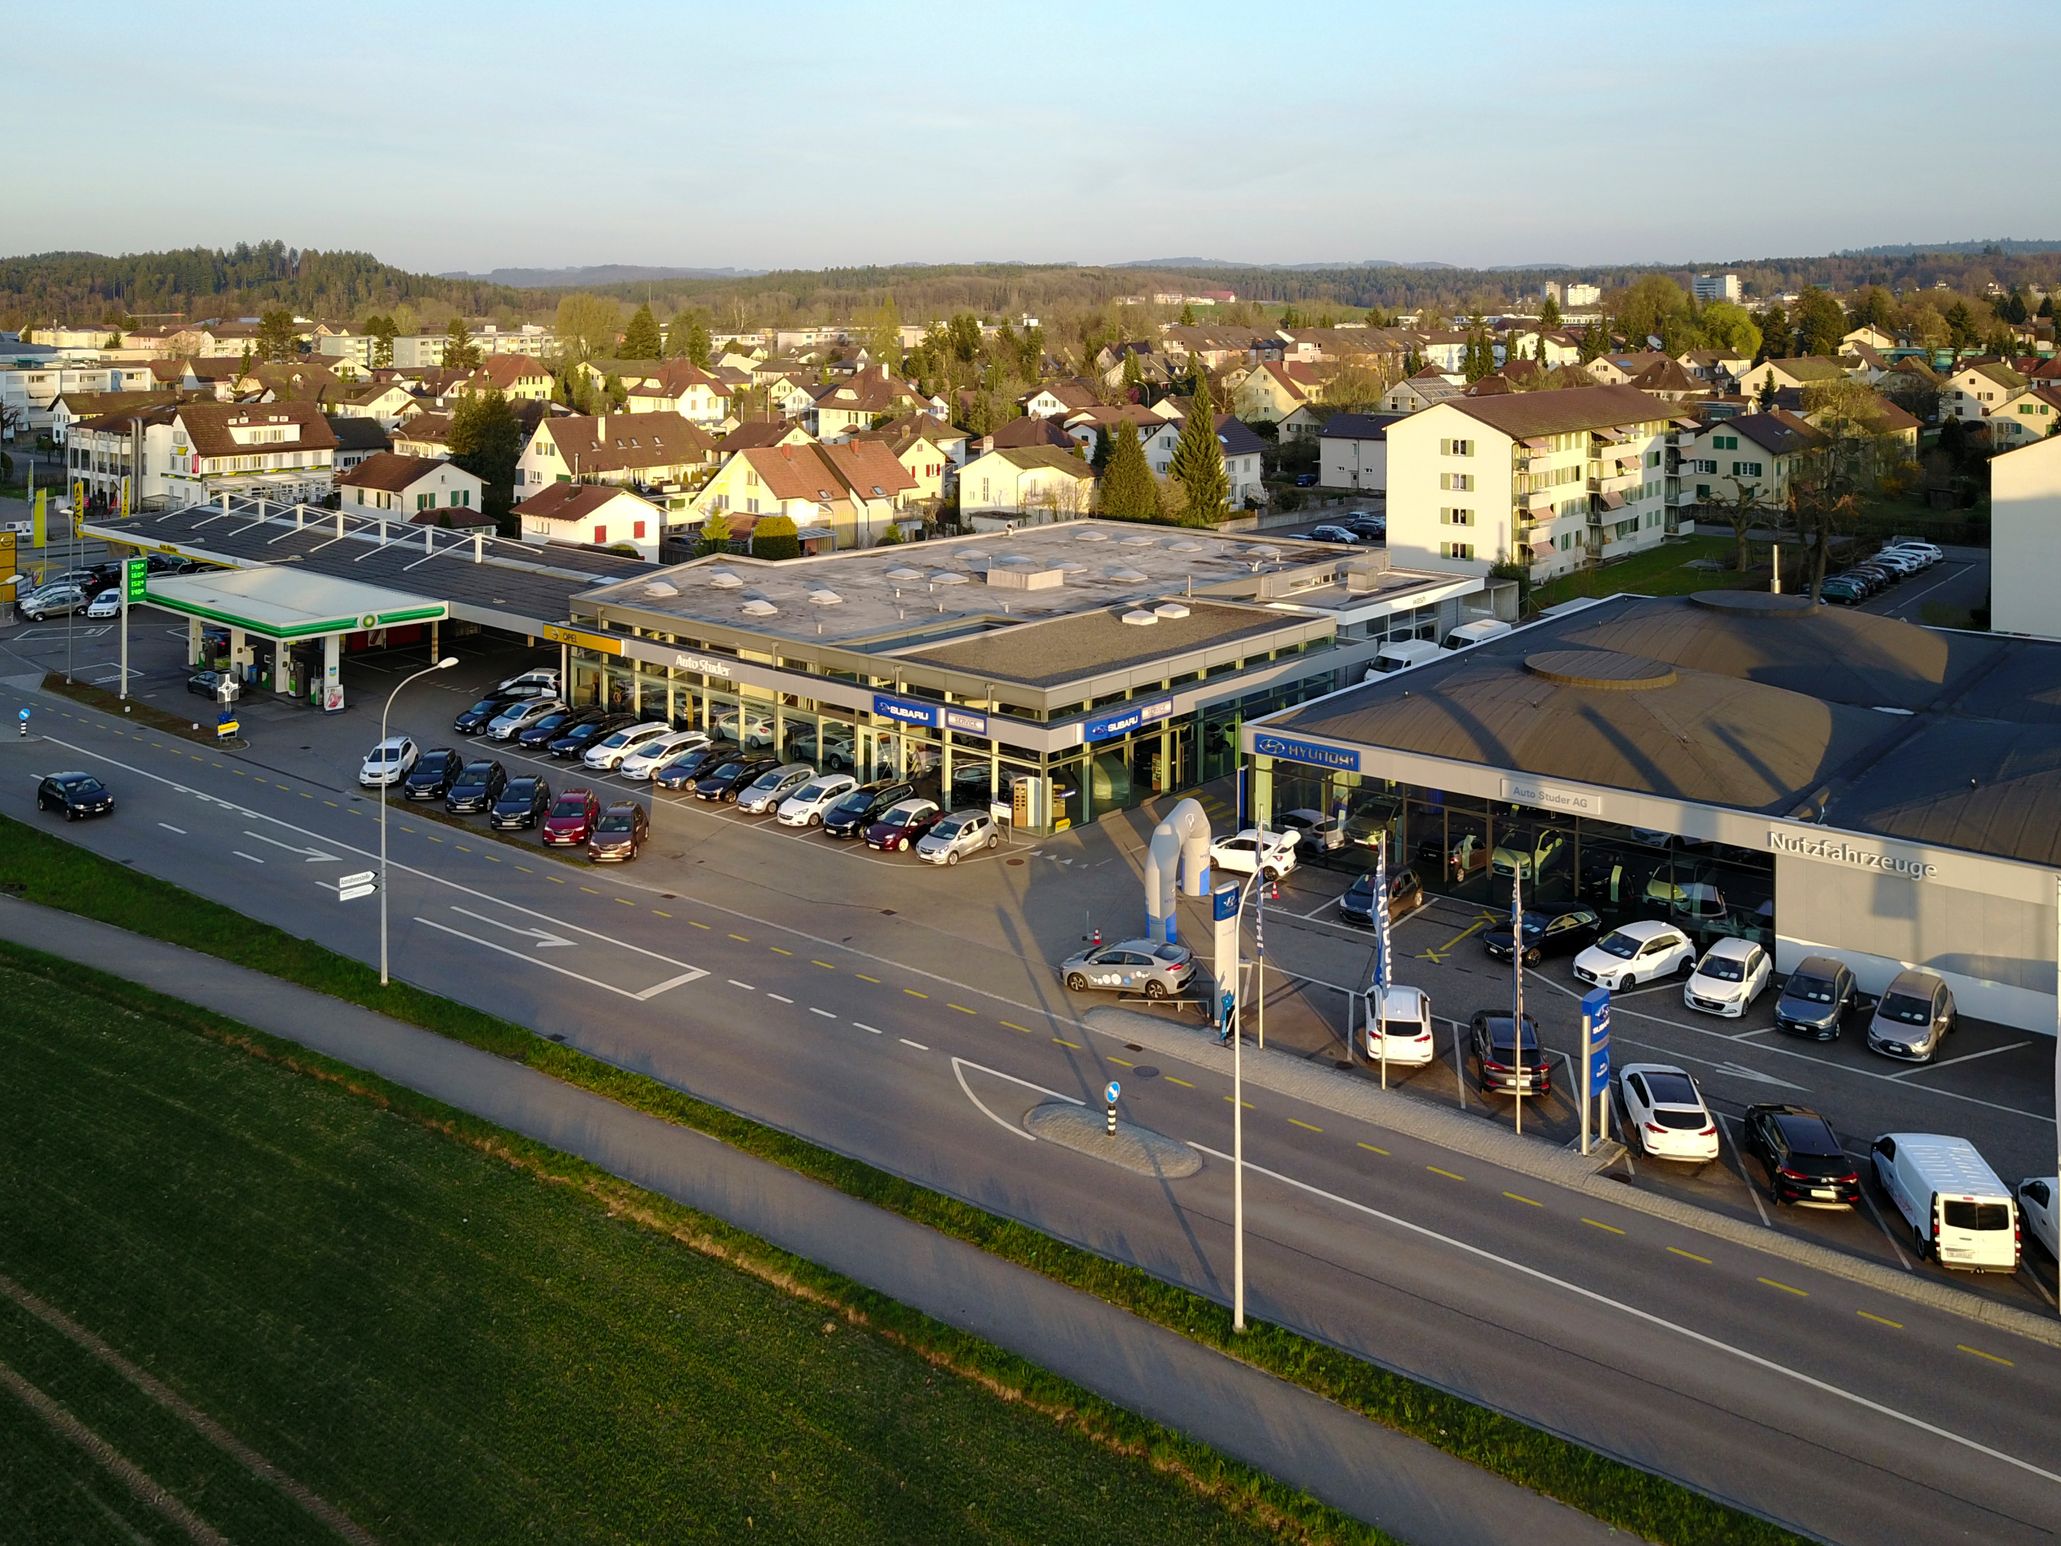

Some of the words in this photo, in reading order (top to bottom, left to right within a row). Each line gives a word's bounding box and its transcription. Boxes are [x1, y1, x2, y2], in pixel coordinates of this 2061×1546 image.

[562, 632, 577, 643] OPEL
[675, 654, 698, 669] Auto
[699, 659, 731, 677] Studer
[890, 705, 928, 721] SUBARU
[1107, 715, 1139, 732] SUBARU
[1288, 745, 1354, 766] HYUNDAI
[1512, 786, 1536, 799] Auto
[1538, 790, 1570, 805] Studer
[1572, 797, 1588, 808] AG
[1768, 831, 1938, 881] Nutzfahrzeuge
